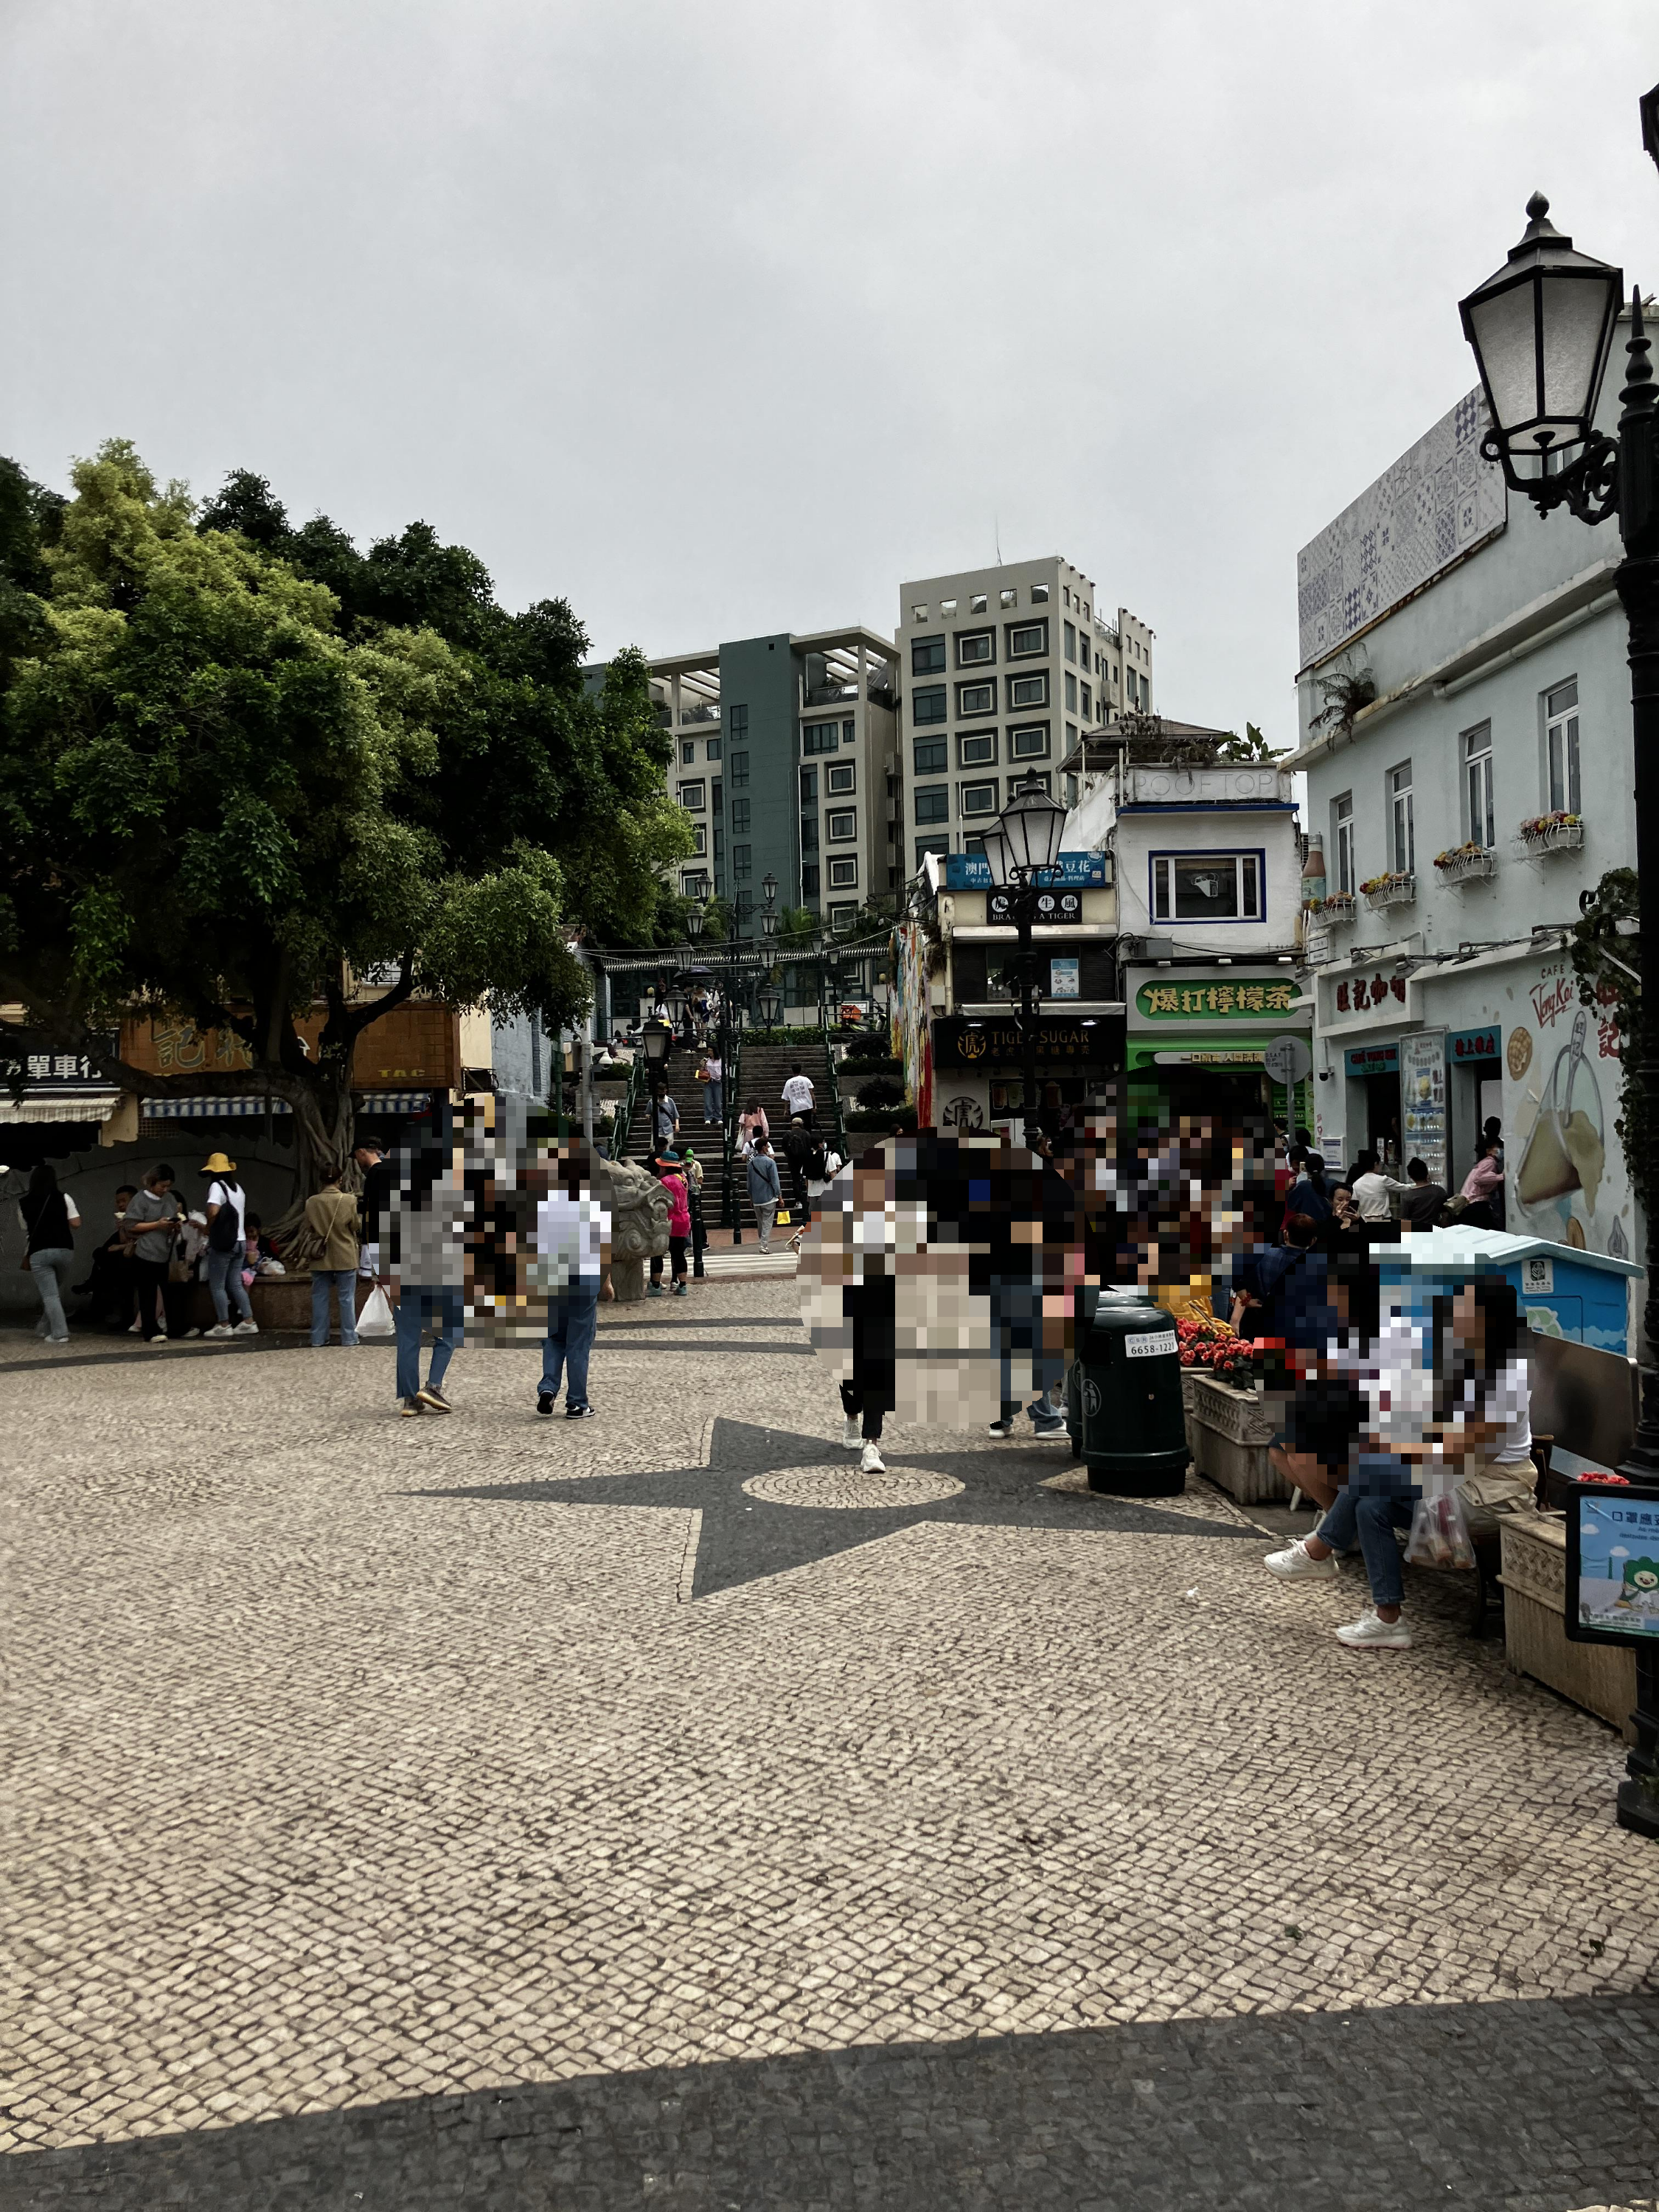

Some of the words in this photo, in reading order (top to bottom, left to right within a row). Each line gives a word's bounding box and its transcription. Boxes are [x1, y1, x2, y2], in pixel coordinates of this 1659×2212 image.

[1541, 964, 1565, 979] CAFE
[1143, 984, 1293, 1015] 爆打檸檬茶
[992, 1031, 1024, 1045] TIGE
[1039, 1029, 1089, 1044] SUGAR
[1131, 1342, 1175, 1354] 6658-1221
